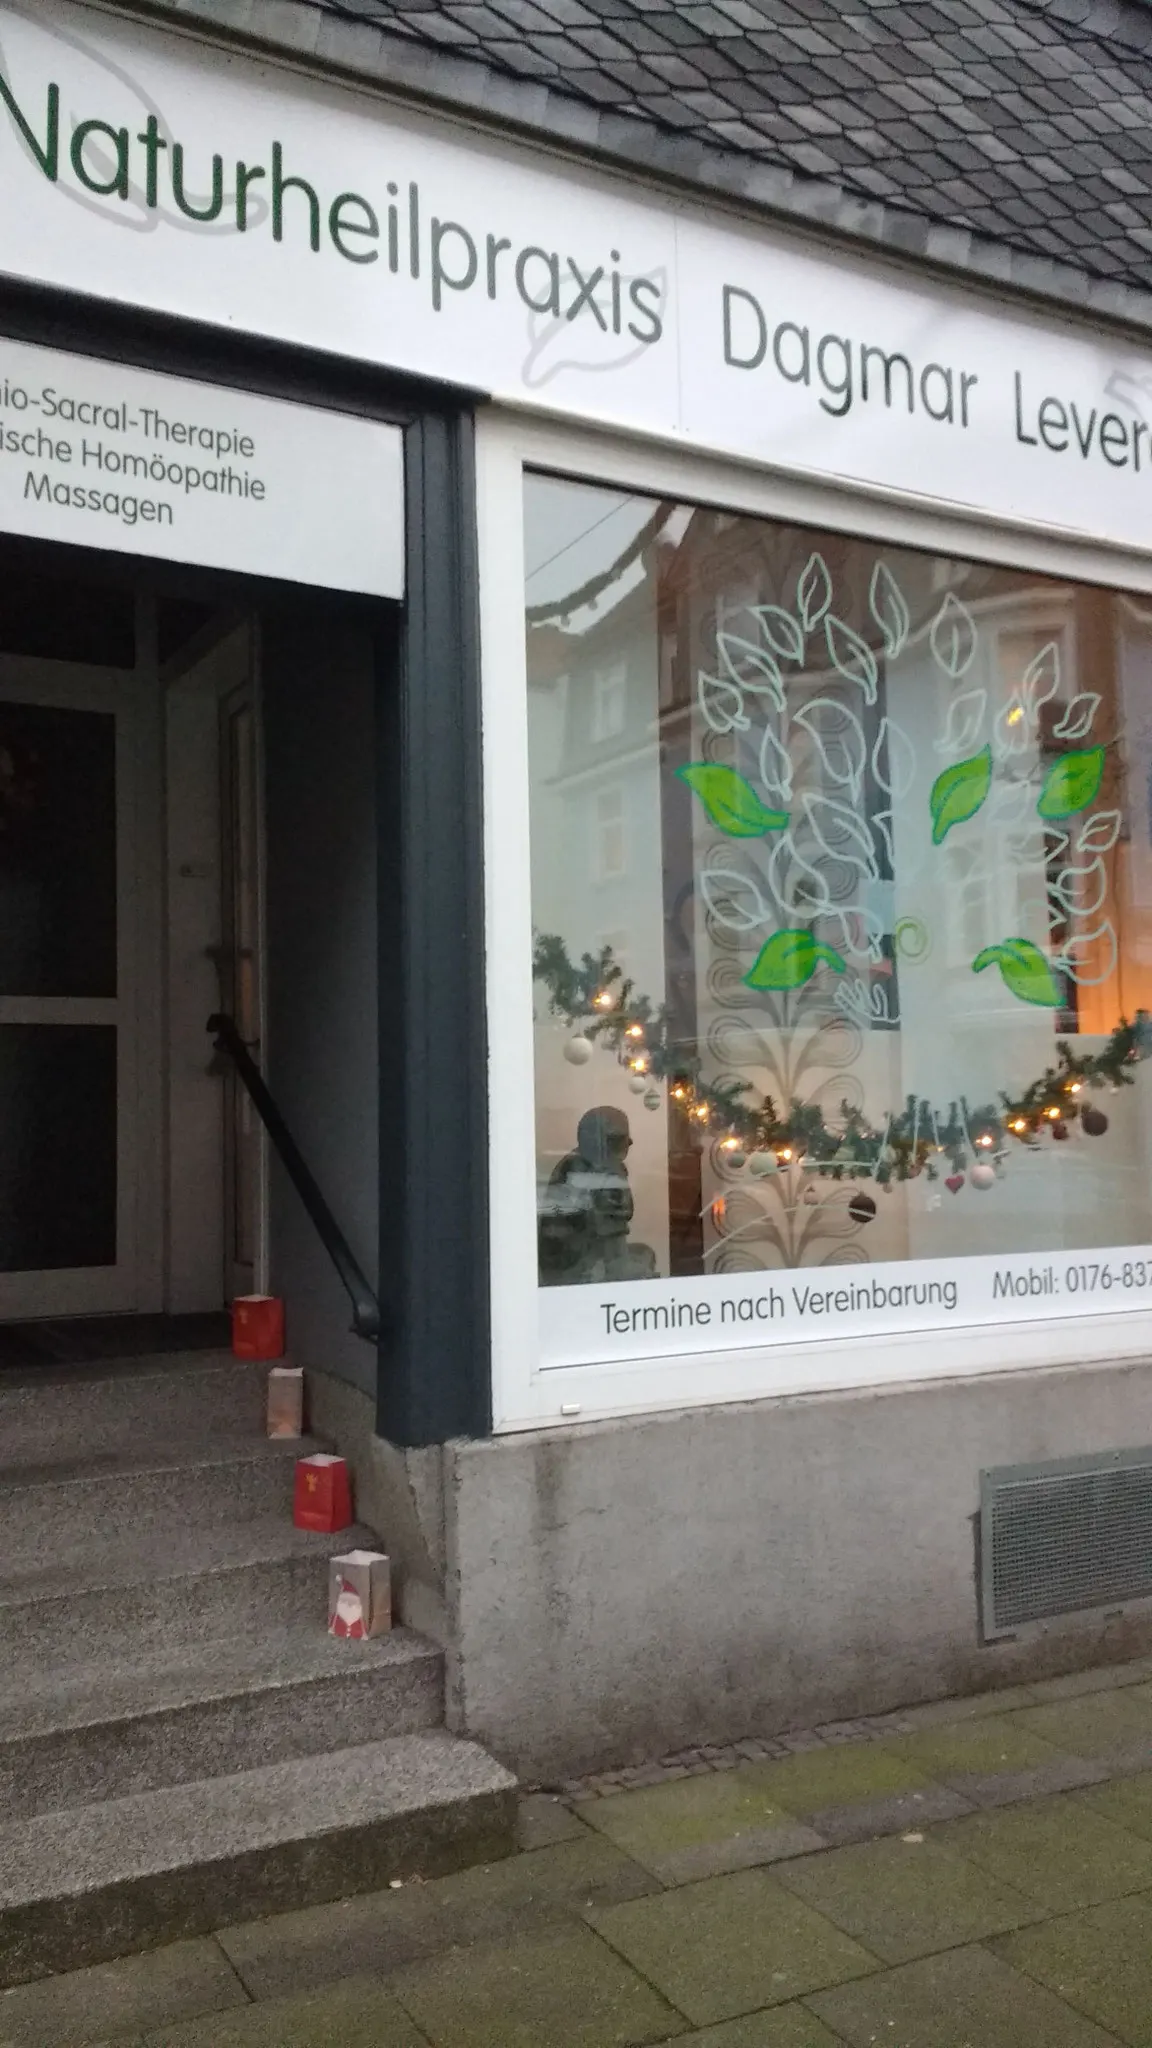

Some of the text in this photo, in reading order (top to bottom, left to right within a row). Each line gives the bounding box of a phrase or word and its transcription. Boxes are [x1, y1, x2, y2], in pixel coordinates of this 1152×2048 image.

[0, 73, 1152, 472] Naturheilpraxis Dagmar Lever
[0, 378, 256, 458] io-Sacral-Therapie
[23, 471, 174, 526] Massagen
[81, 438, 266, 501] Homöopathie
[600, 1298, 712, 1335] Termine
[720, 1289, 785, 1323] nach
[792, 1279, 958, 1317] Vereinbarung
[992, 1265, 1060, 1300] Mobil:
